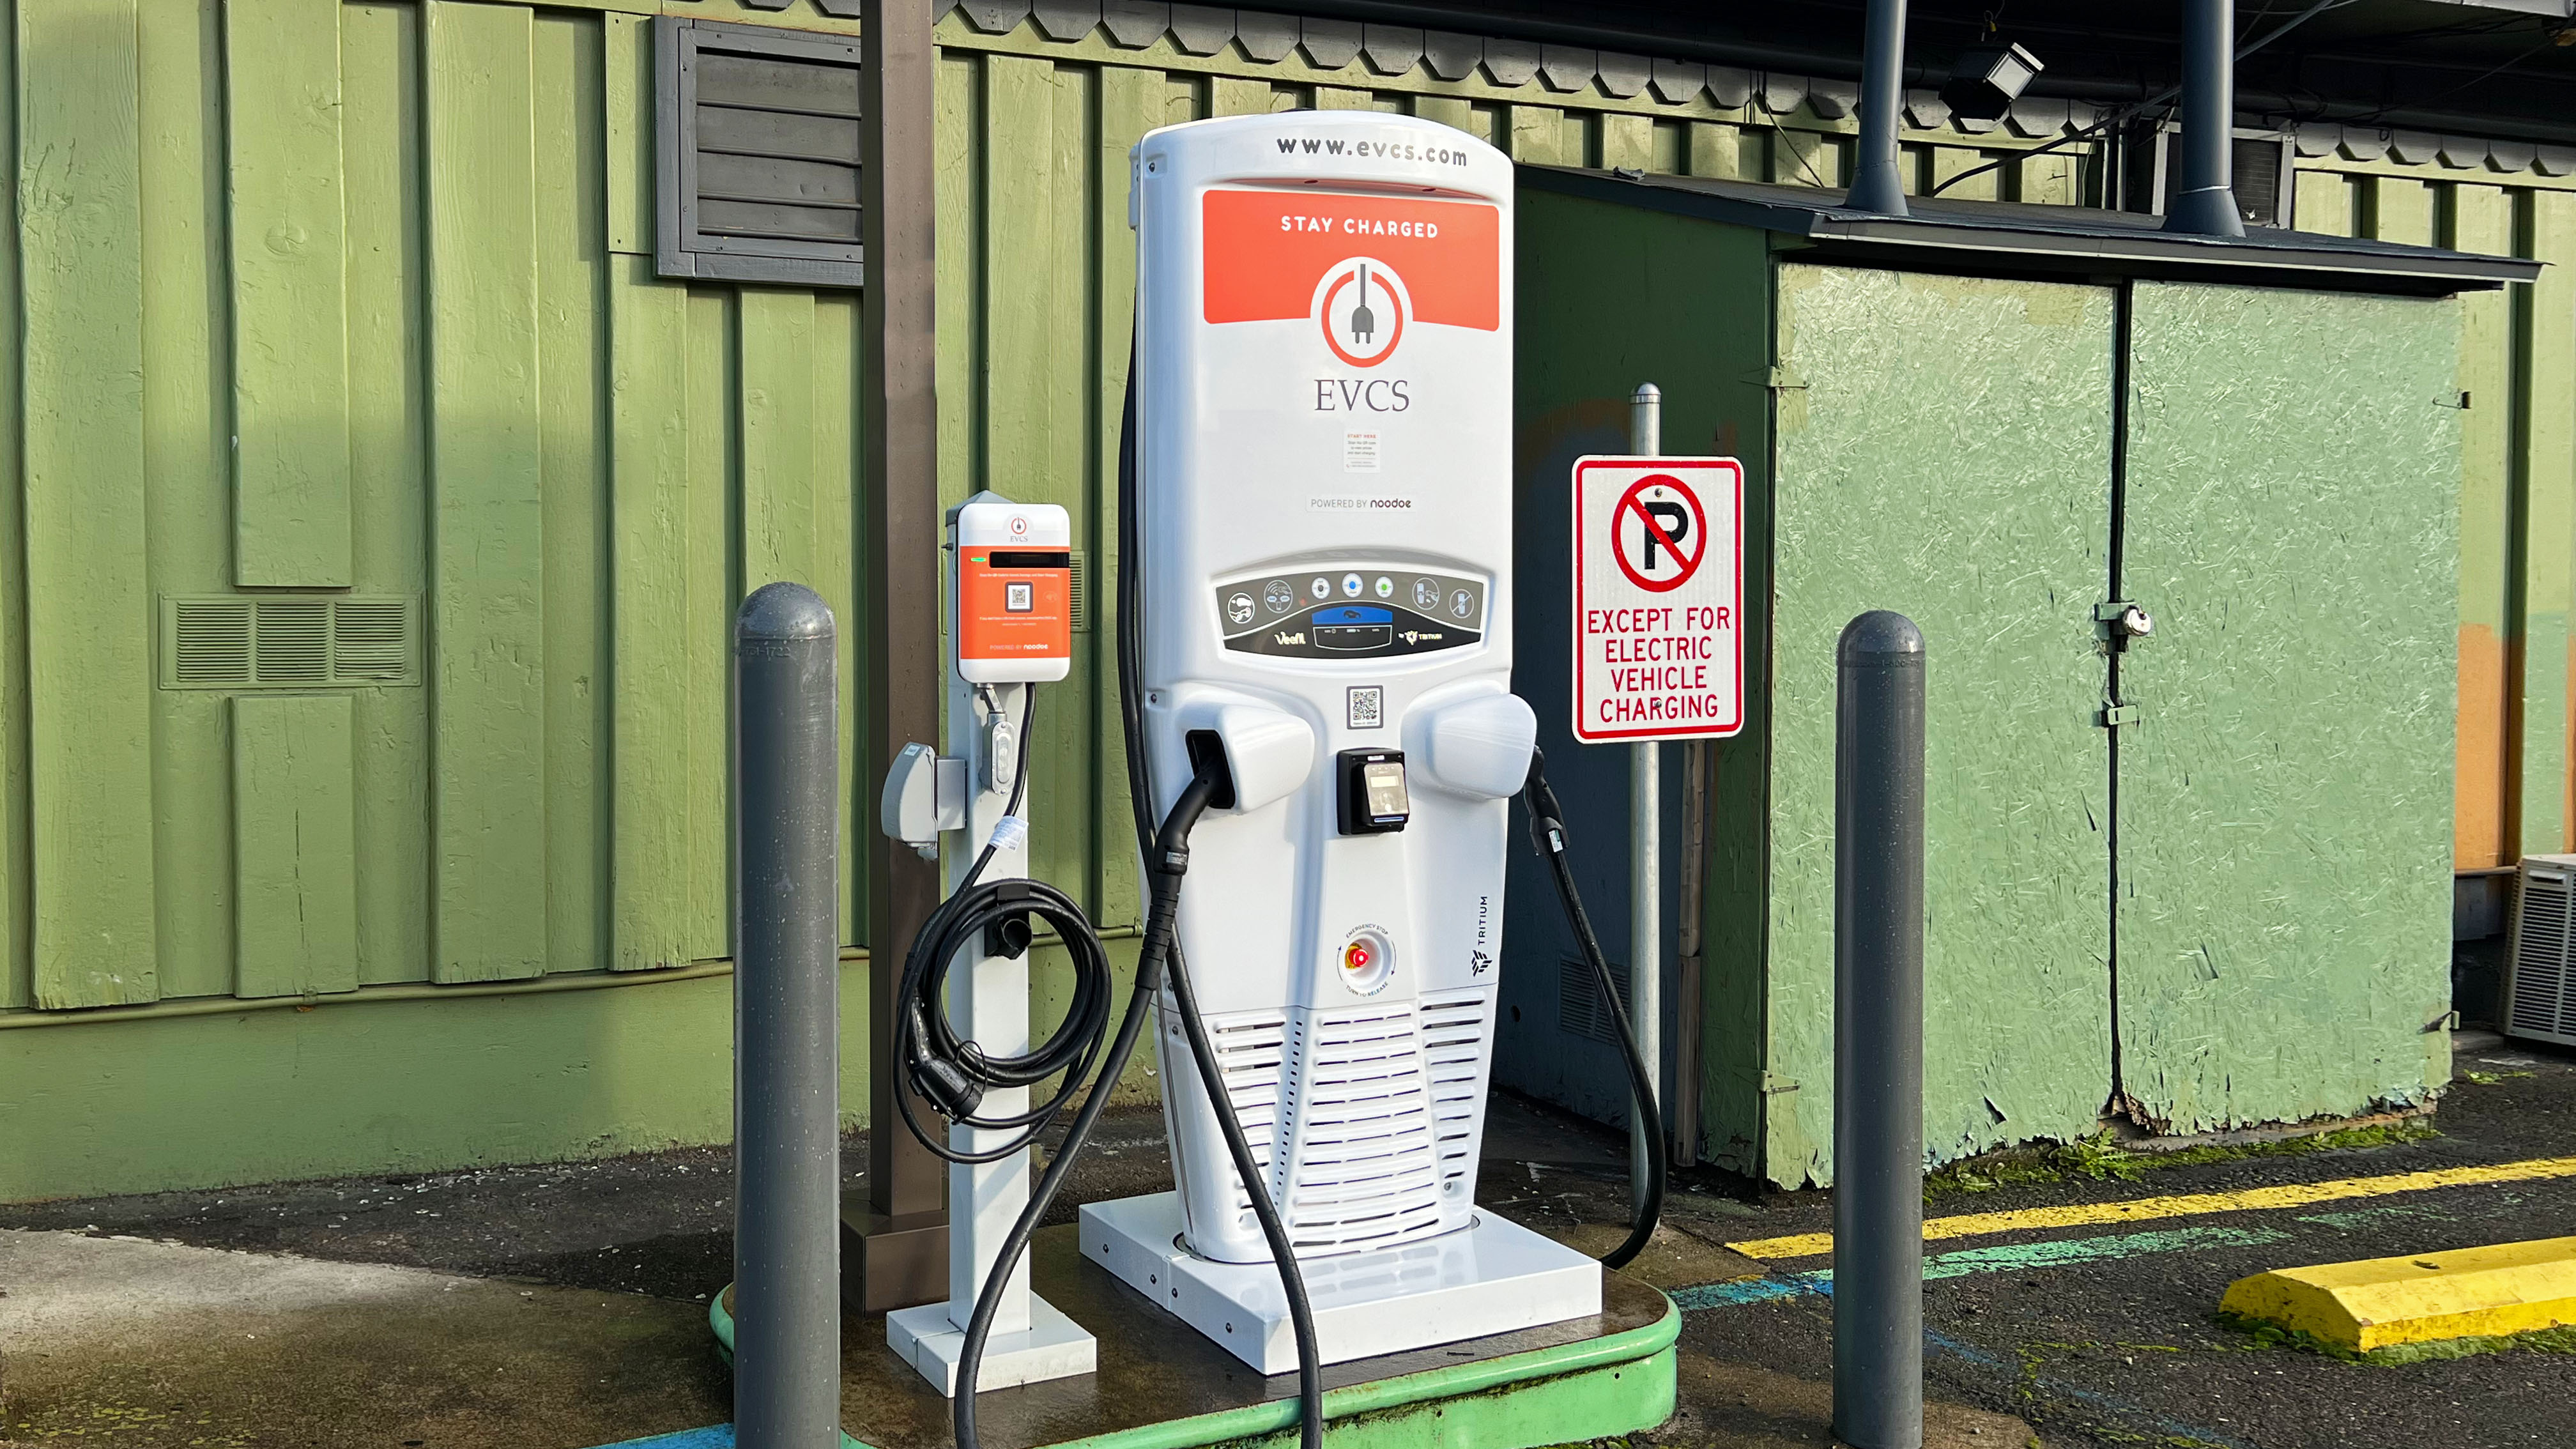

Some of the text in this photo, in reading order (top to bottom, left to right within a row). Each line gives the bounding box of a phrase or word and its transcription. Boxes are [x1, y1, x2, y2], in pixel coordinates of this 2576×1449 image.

[1276, 137, 1468, 167] www.evcs.com
[1280, 215, 1439, 238] STAY CHARGED
[1314, 379, 1409, 412] EVCS
[1311, 498, 1411, 509] POWERED BY noodoe
[1588, 606, 1730, 634] EXCEPT FOR
[1606, 636, 1712, 663] ELECTRIC
[1610, 665, 1707, 693] VEHICLE
[1600, 694, 1719, 723] CHARGING
[1346, 923, 1389, 939] EMERGENCY STOP
[1478, 896, 1488, 946] TRITIUM
[1367, 981, 1389, 997] RELEASE
